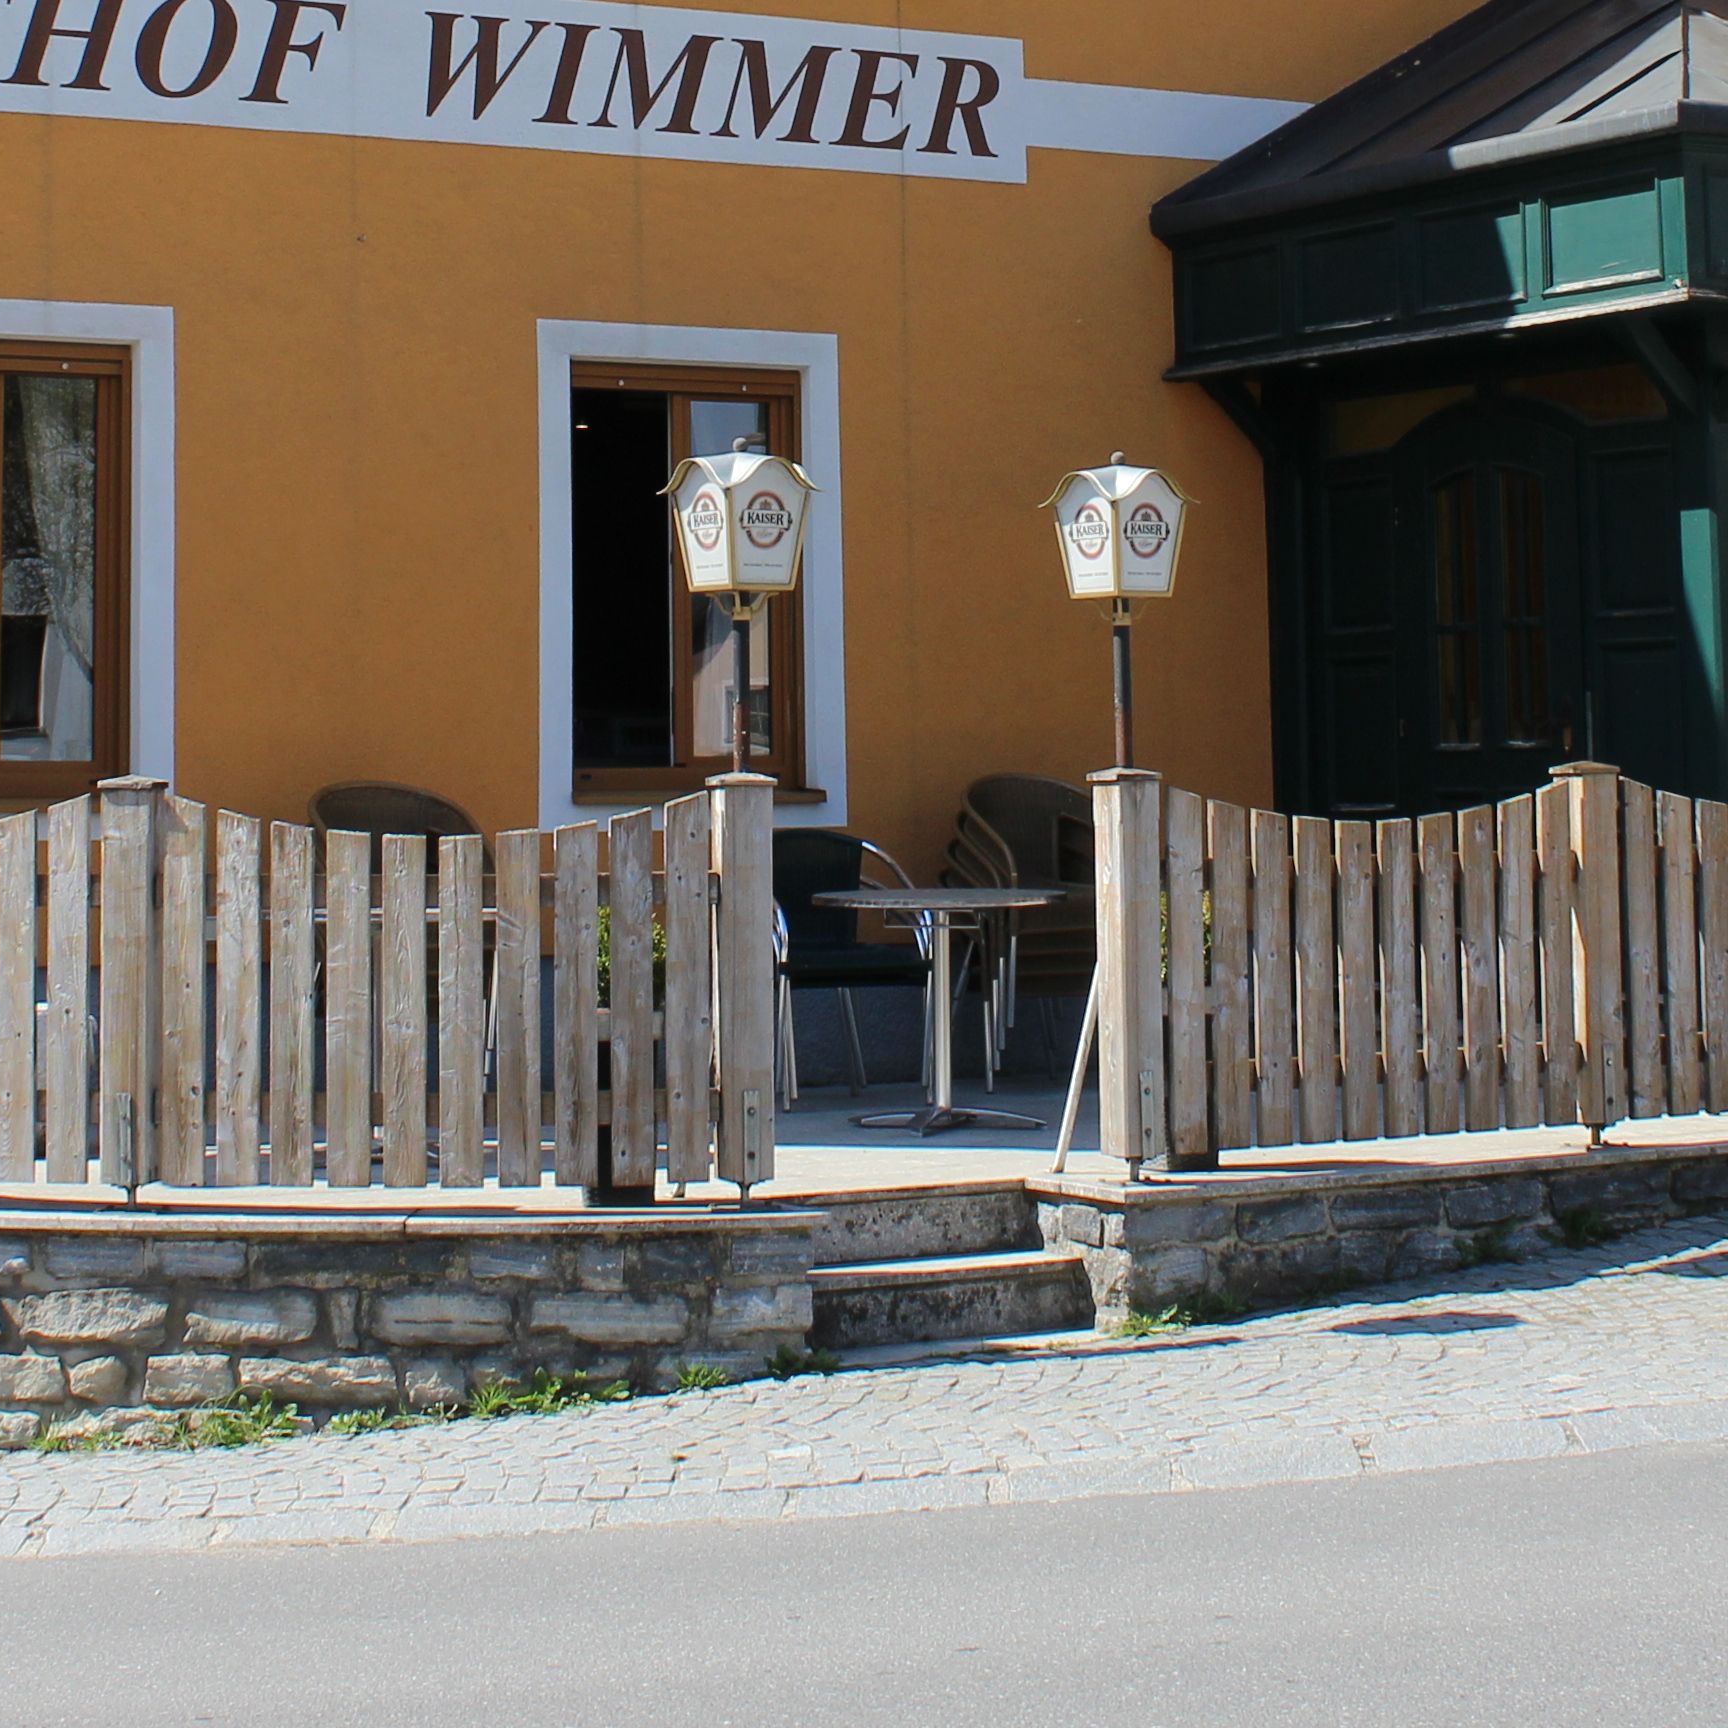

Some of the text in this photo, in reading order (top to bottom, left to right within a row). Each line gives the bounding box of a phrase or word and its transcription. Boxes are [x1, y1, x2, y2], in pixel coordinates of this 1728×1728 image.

[424, 11, 1001, 158] WIMMER
[693, 513, 719, 527] KAISER
[747, 511, 784, 526] KAISER
[1076, 524, 1104, 537] KAISER
[1130, 523, 1162, 536] KAISER
